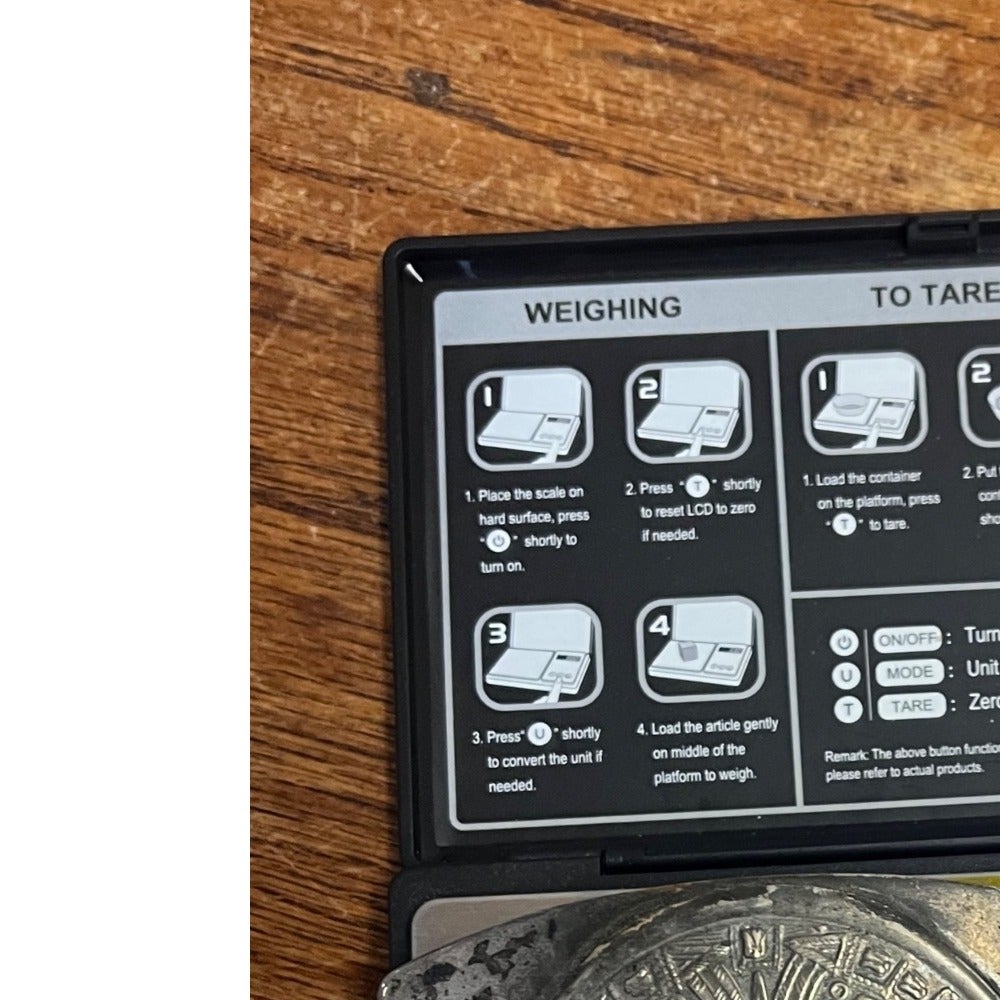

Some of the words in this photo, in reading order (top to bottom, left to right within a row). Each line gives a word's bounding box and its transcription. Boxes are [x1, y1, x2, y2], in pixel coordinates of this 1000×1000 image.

[871, 286, 911, 308] TO
[525, 296, 682, 323] WEIGHING
[971, 362, 991, 383] 2
[638, 378, 658, 399] 2
[803, 474, 814, 486] 1.
[815, 473, 845, 486] Load
[847, 472, 866, 484] the
[868, 471, 922, 483] container
[976, 466, 997, 478] Put
[465, 490, 475, 502] 1.
[479, 489, 511, 502] Place
[514, 488, 533, 501] the
[535, 487, 566, 500] scale
[569, 488, 584, 497] on
[626, 483, 637, 496] 2.
[640, 482, 673, 494] Press
[723, 478, 761, 492] shortly
[817, 500, 833, 509] on
[834, 497, 854, 508] the
[908, 494, 941, 508] press
[479, 512, 506, 526] hard
[509, 510, 555, 524] surface,
[558, 511, 590, 523] press
[640, 506, 652, 518] to
[655, 505, 685, 517] reset
[687, 503, 713, 516] LCD
[716, 503, 727, 514] to
[730, 503, 756, 514] zero
[869, 520, 881, 531] to
[883, 518, 910, 530] tare.
[524, 533, 563, 548] shortly
[566, 534, 577, 546] to
[642, 529, 650, 541] if
[652, 528, 699, 541] needed.
[481, 561, 504, 573] turn
[507, 561, 525, 571] on.
[649, 615, 670, 635] 4
[489, 623, 507, 644] 3
[879, 631, 938, 647] ON/OFF
[887, 665, 934, 680] MODE
[966, 659, 1000, 677] Unit
[892, 699, 933, 713] TARE
[637, 724, 648, 736] 4.
[652, 722, 682, 735] Load
[685, 721, 703, 733] the
[705, 719, 741, 732] article
[744, 717, 779, 732] gently
[472, 732, 483, 744] 3.
[562, 726, 601, 741] shortly
[487, 756, 500, 768] to
[502, 754, 546, 767] convert
[549, 753, 568, 765] the
[571, 752, 593, 764] unit
[596, 750, 603, 762] if
[653, 749, 668, 760] on
[671, 746, 709, 758] middle
[712, 745, 725, 756] of
[727, 743, 746, 756] the
[871, 748, 892, 759] The
[895, 747, 927, 759] above
[929, 745, 962, 756] button
[654, 769, 702, 786] platform
[705, 769, 716, 781] to
[719, 767, 757, 783] weigh.
[826, 769, 861, 783] please
[863, 766, 888, 779] refer
[890, 767, 901, 777] to
[903, 764, 934, 776] actual
[936, 762, 985, 777] products.
[489, 780, 536, 792] needed.
